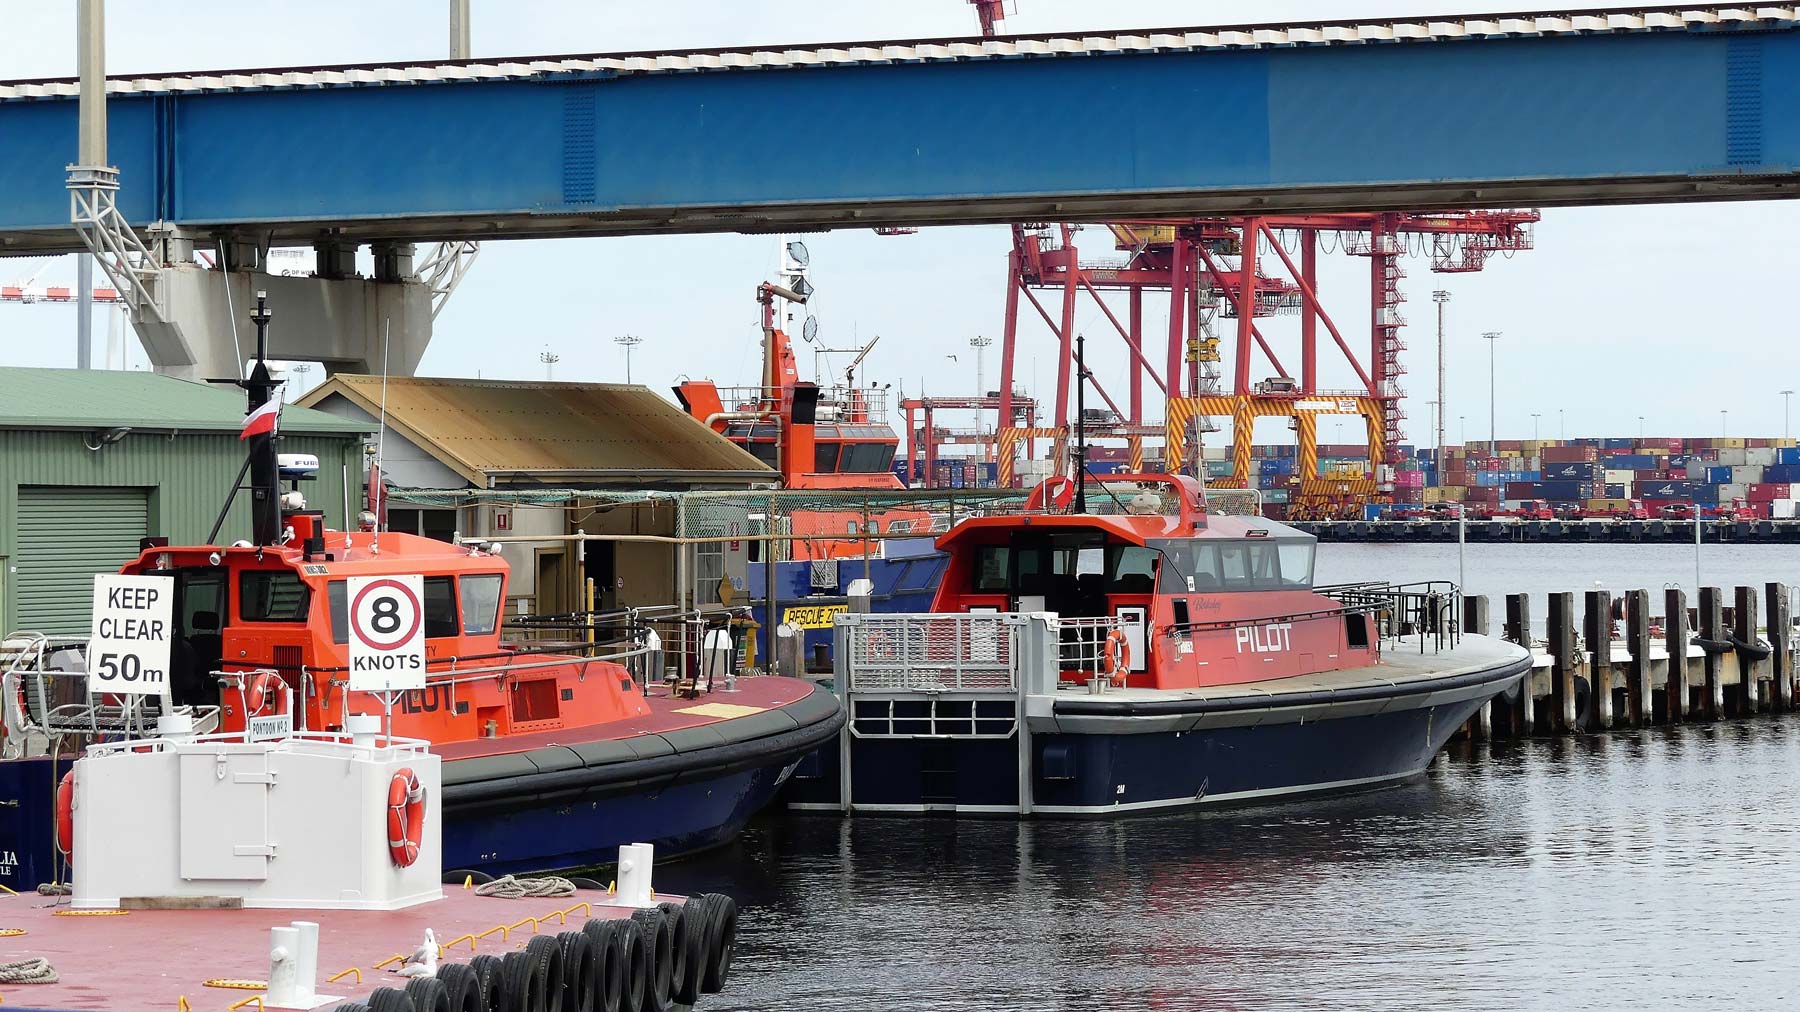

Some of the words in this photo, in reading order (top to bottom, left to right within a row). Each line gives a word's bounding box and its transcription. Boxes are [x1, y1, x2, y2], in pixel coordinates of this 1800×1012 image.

[108, 587, 159, 610] KEEP
[371, 596, 401, 634] 8
[789, 608, 825, 625] RESCUE
[100, 618, 164, 640] CLEAR
[1235, 623, 1292, 654] PILOT
[354, 654, 420, 672] KNOTS
[252, 722, 276, 736] PONTOON
